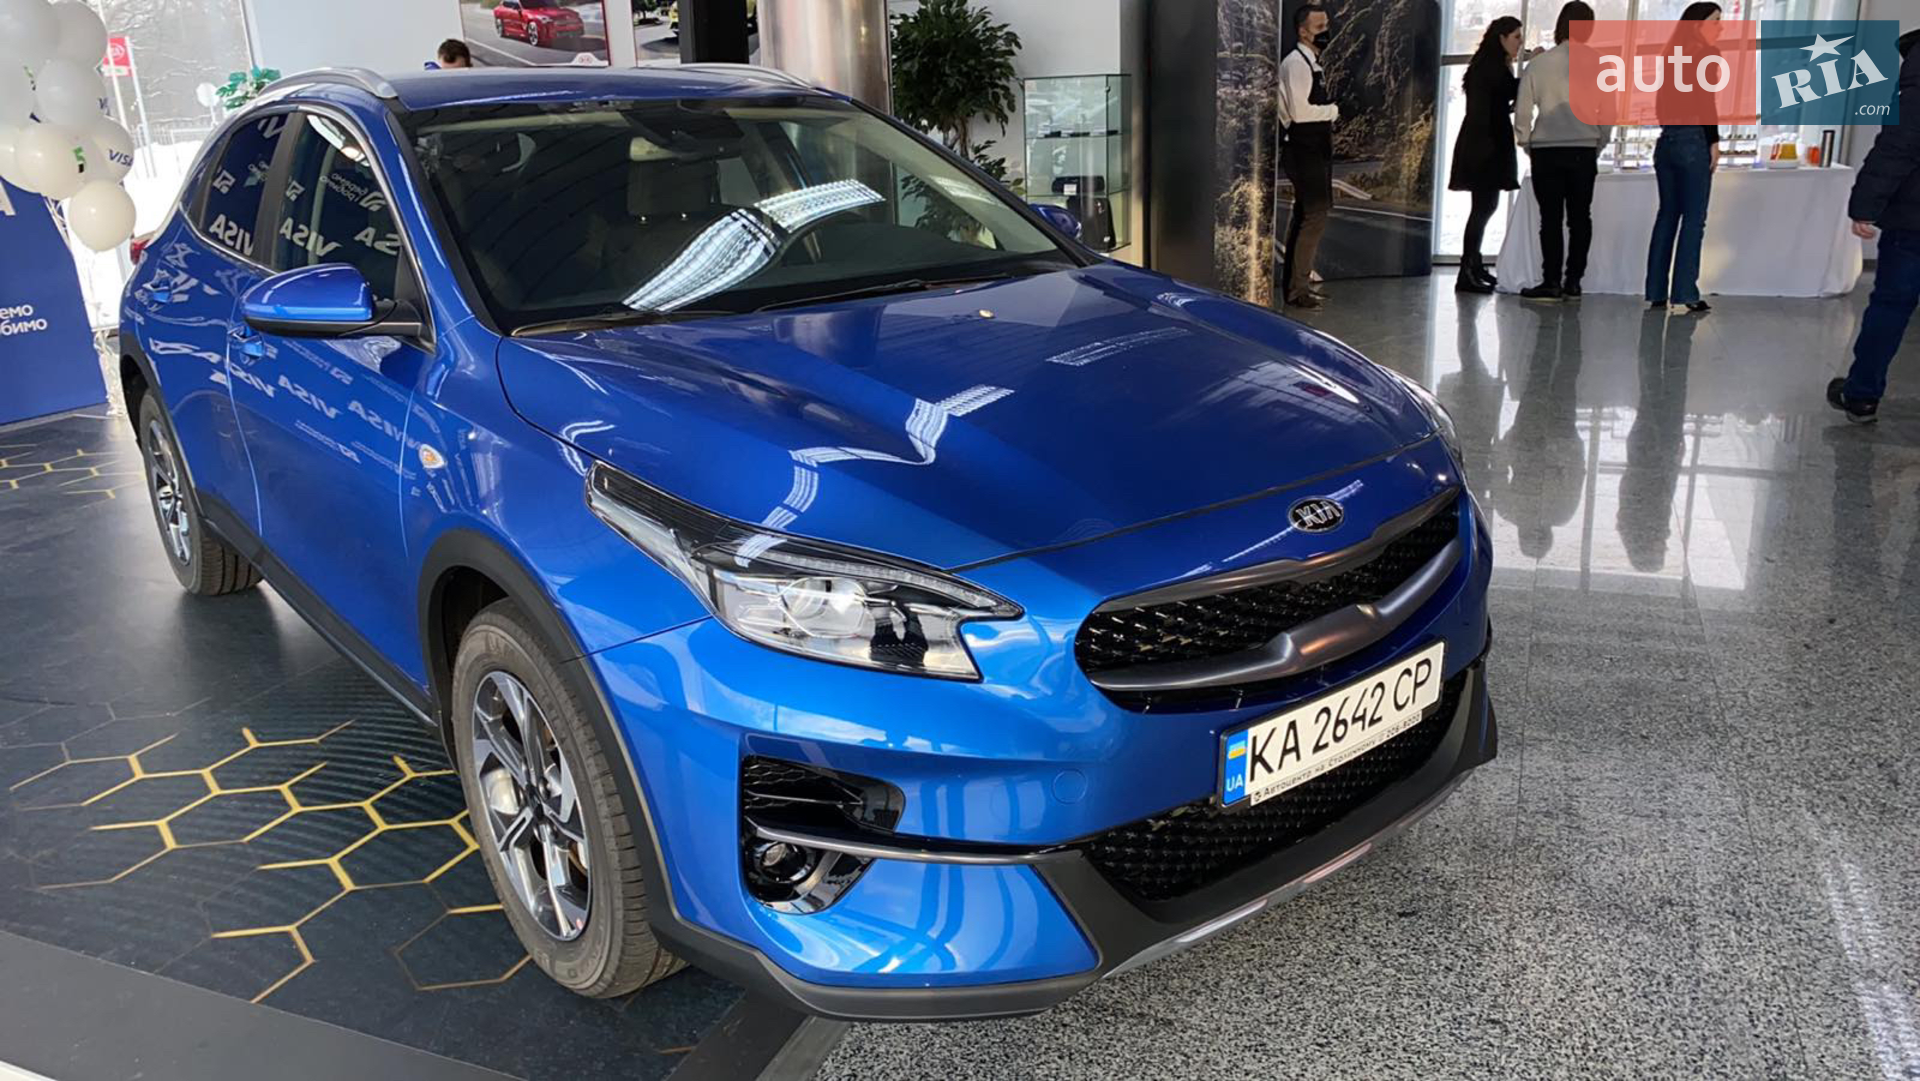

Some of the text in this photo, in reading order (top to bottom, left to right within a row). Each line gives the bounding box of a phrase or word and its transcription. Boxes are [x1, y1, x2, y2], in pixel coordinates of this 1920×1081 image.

[1295, 501, 1341, 527] KIA
[1249, 657, 1432, 783] KA 2642 CP
[1226, 773, 1244, 792] UA
